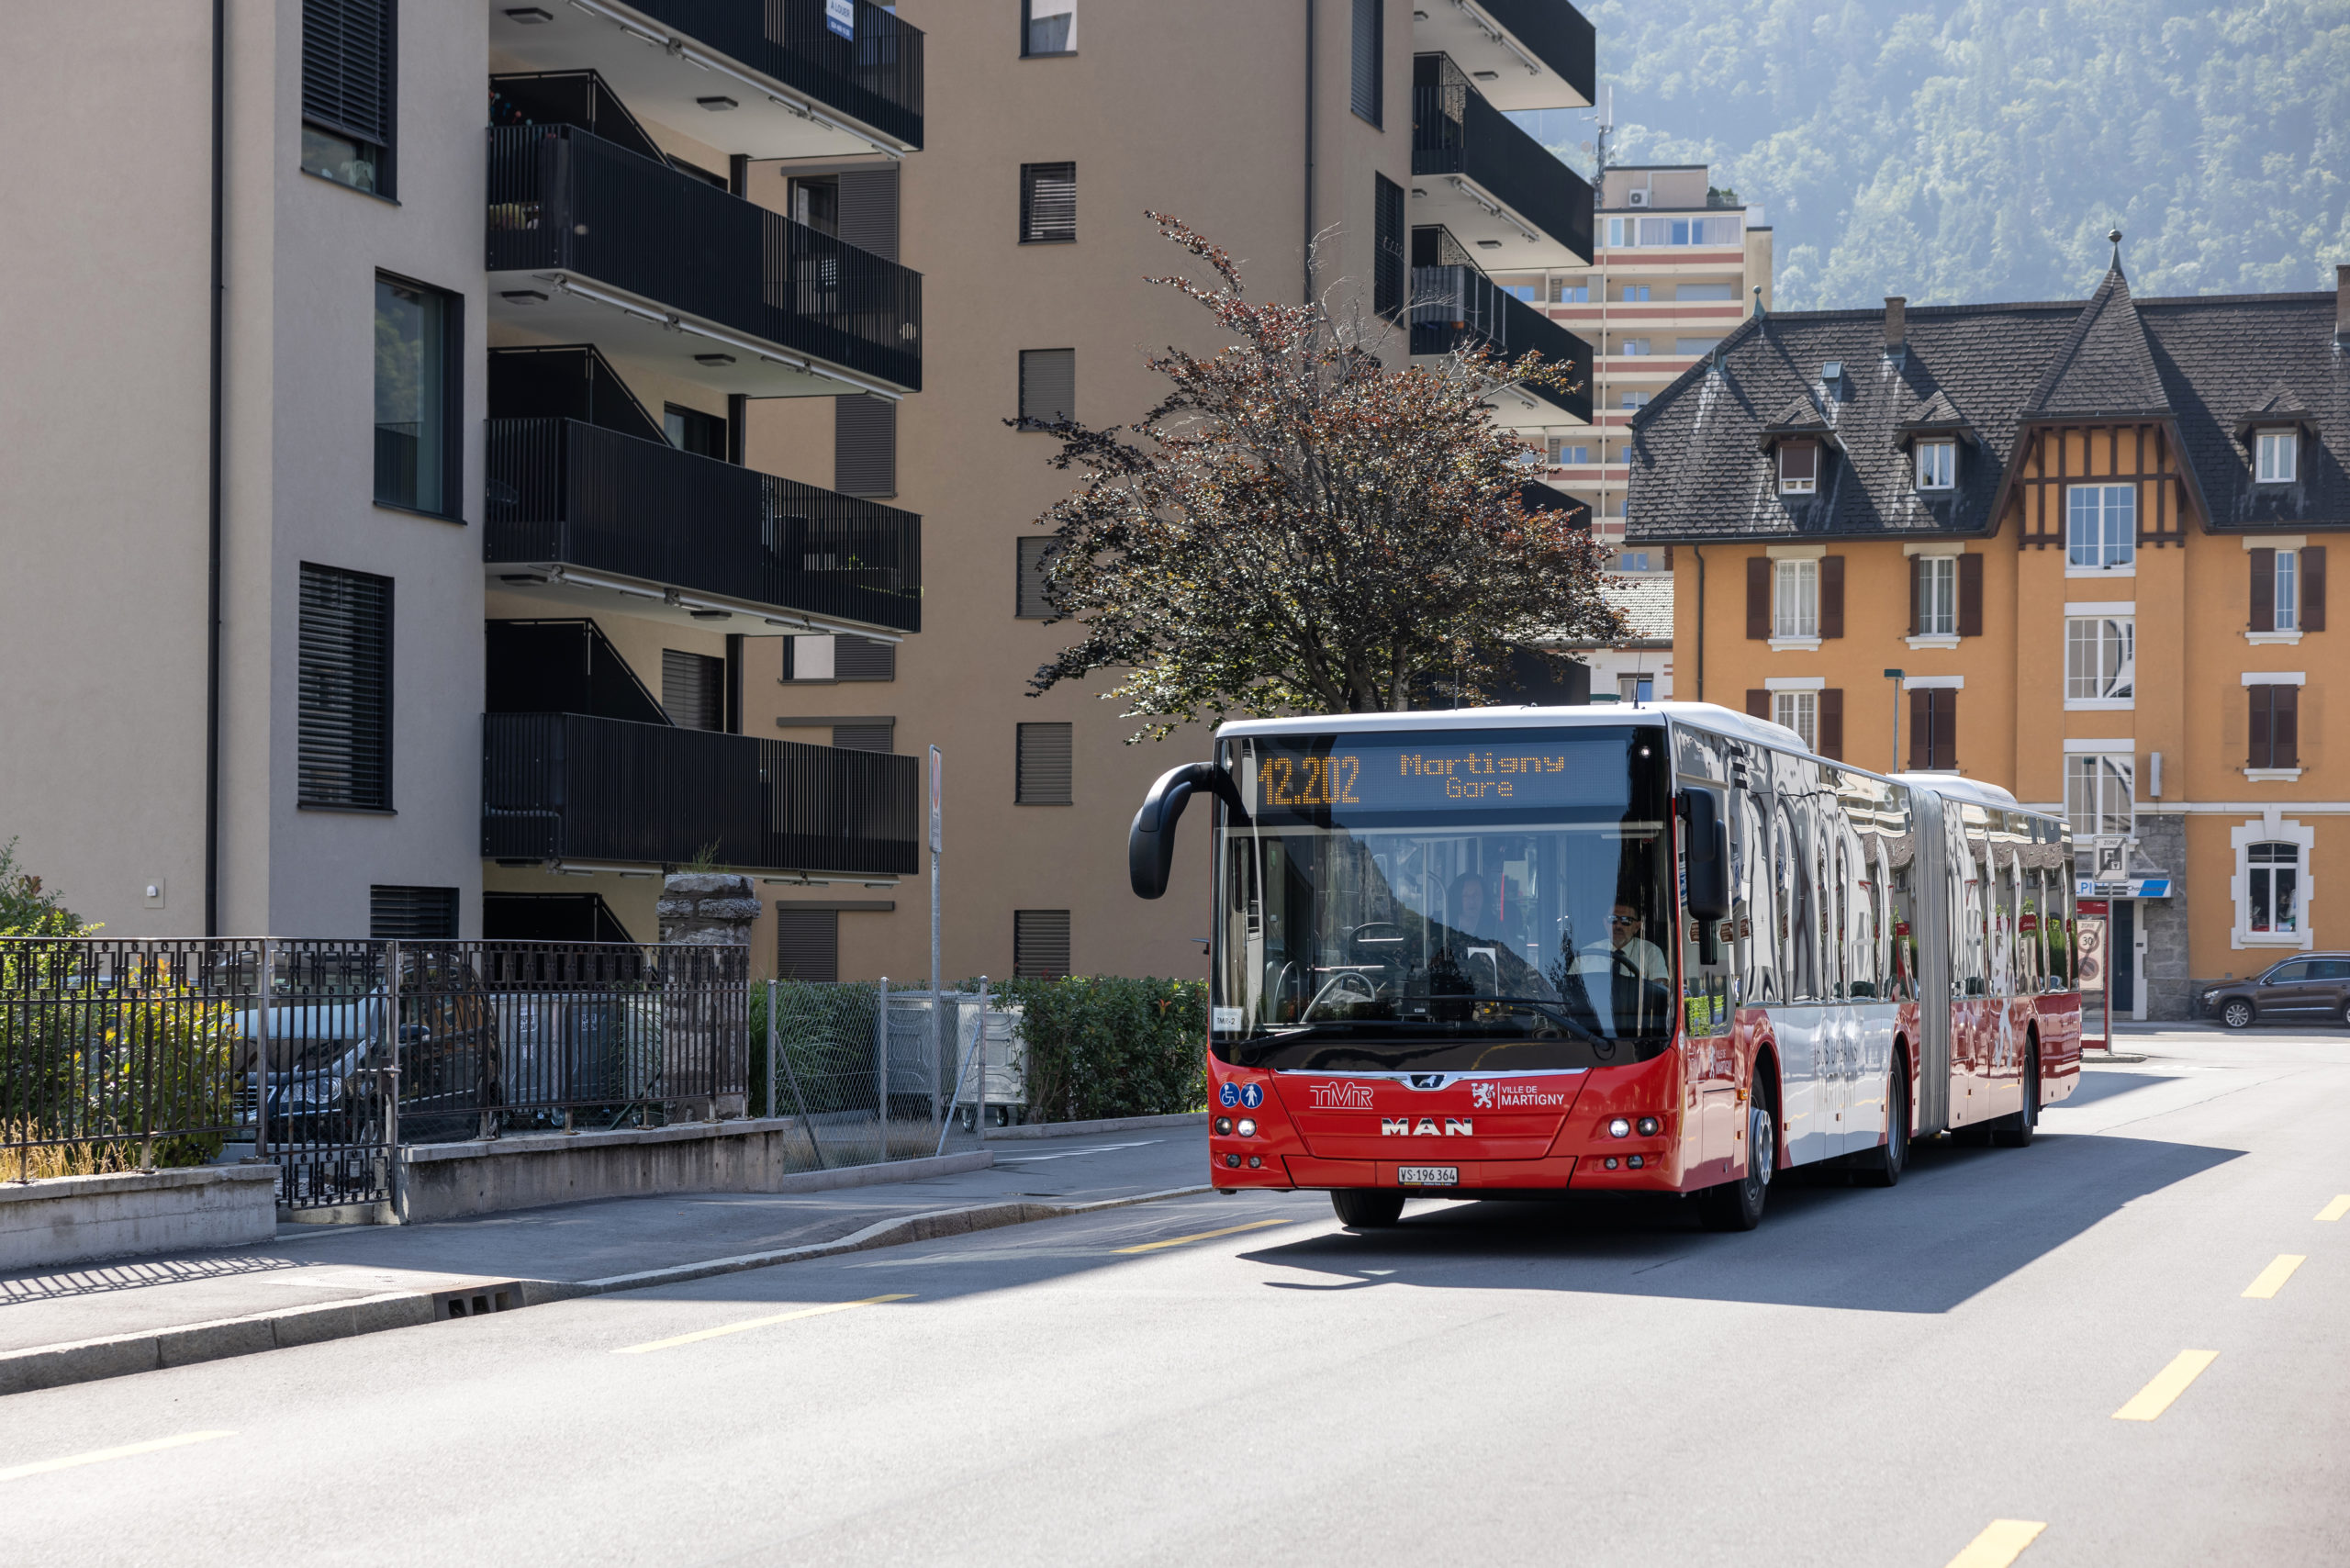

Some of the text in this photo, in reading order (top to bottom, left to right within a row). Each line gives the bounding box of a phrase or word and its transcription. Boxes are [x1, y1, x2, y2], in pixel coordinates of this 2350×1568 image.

[1259, 753, 1565, 805] 12.202 Martigny
[1447, 777, 1514, 799] Gare
[2083, 936, 2094, 946] 30
[1502, 1085, 1538, 1094] VILLE DE
[1501, 1093, 1564, 1106] MARTIGNY
[1382, 1117, 1473, 1137] MAN
